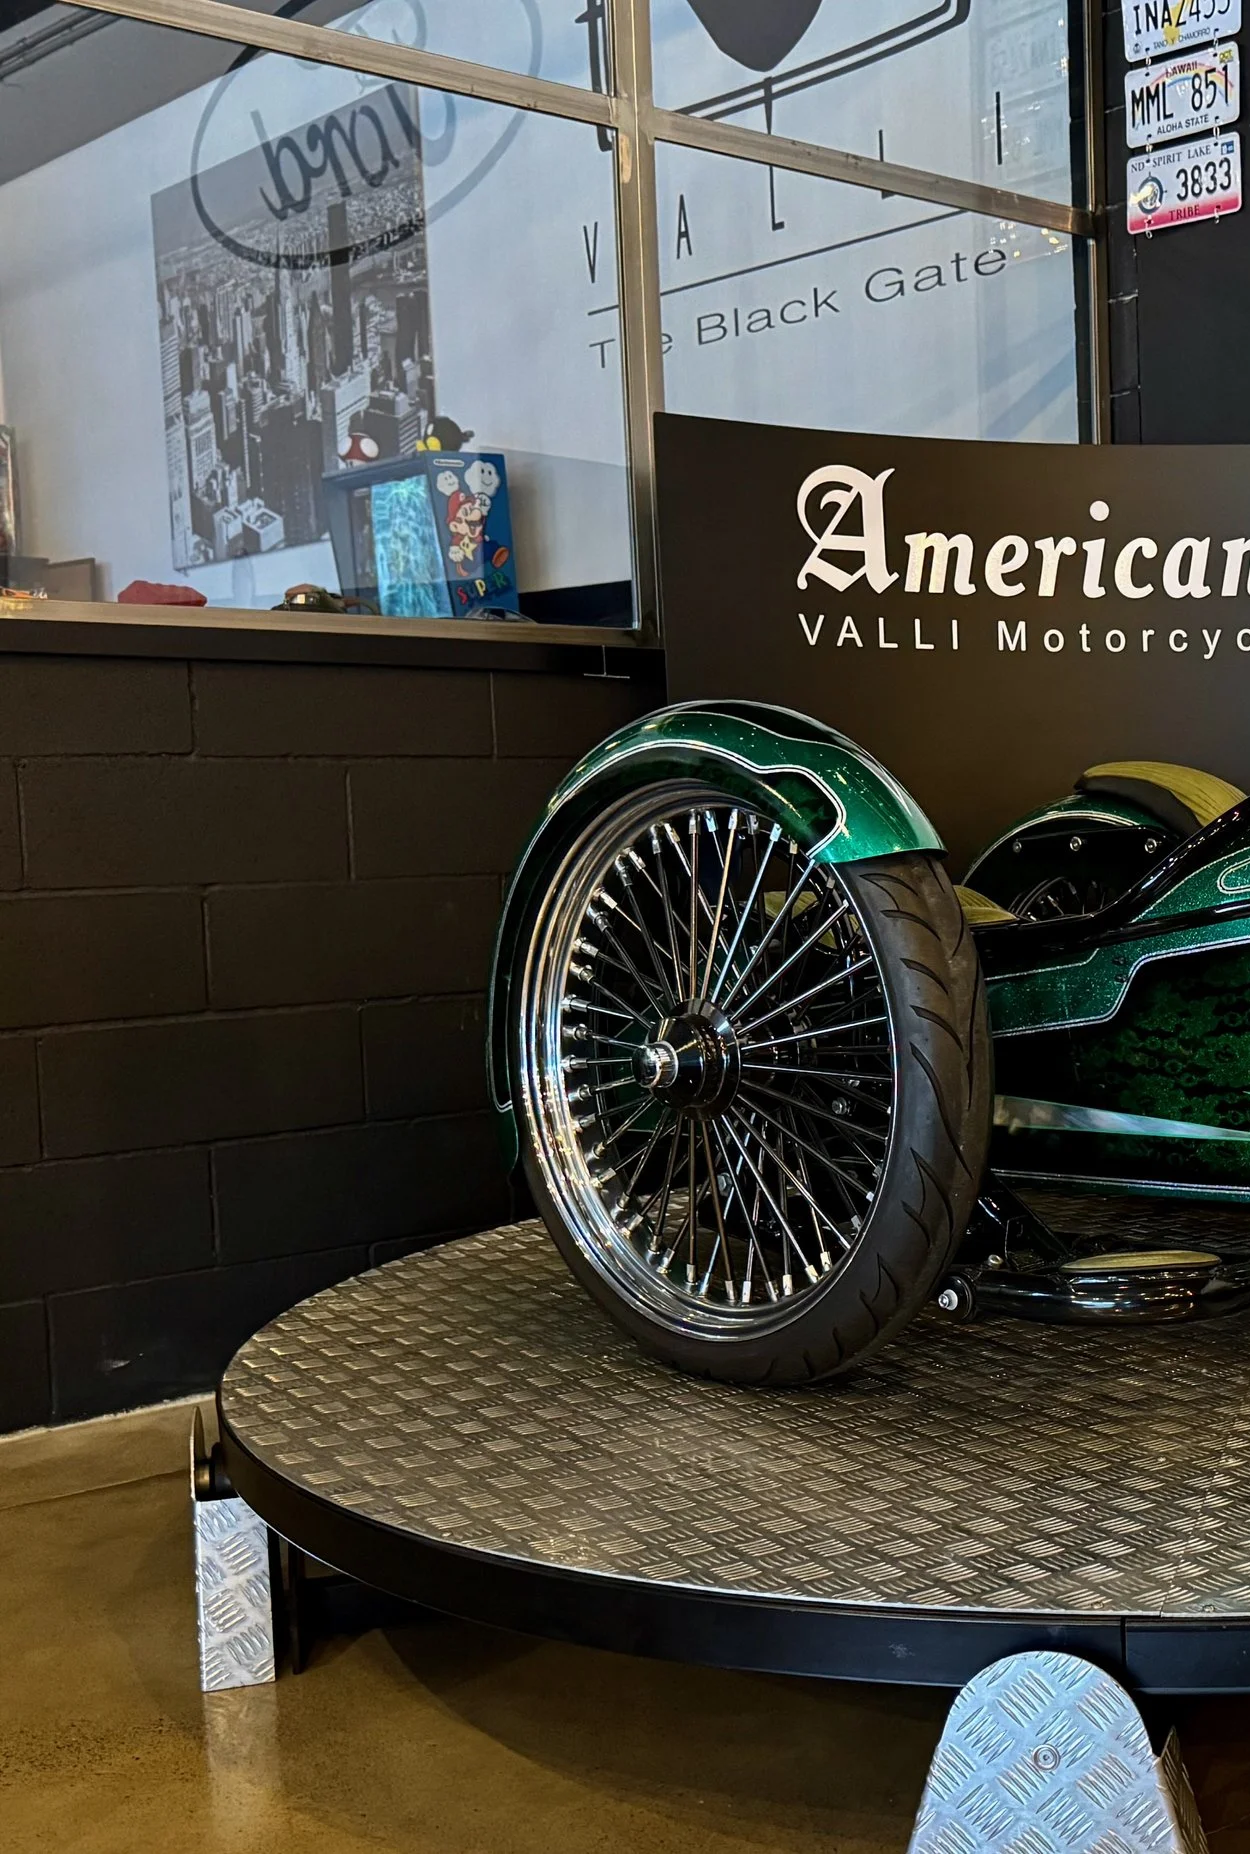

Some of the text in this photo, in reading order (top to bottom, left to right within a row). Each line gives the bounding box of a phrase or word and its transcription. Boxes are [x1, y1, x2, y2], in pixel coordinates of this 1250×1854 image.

[1131, 64, 1229, 128] MML 851
[1157, 114, 1209, 136] ALOHA STATE
[1131, 144, 1212, 174] ND SPIRIT LAKE
[1176, 157, 1232, 201] 3833
[1169, 204, 1201, 222] TRIBE
[589, 246, 1008, 369] Te Black Gate
[798, 613, 959, 650] VALLI
